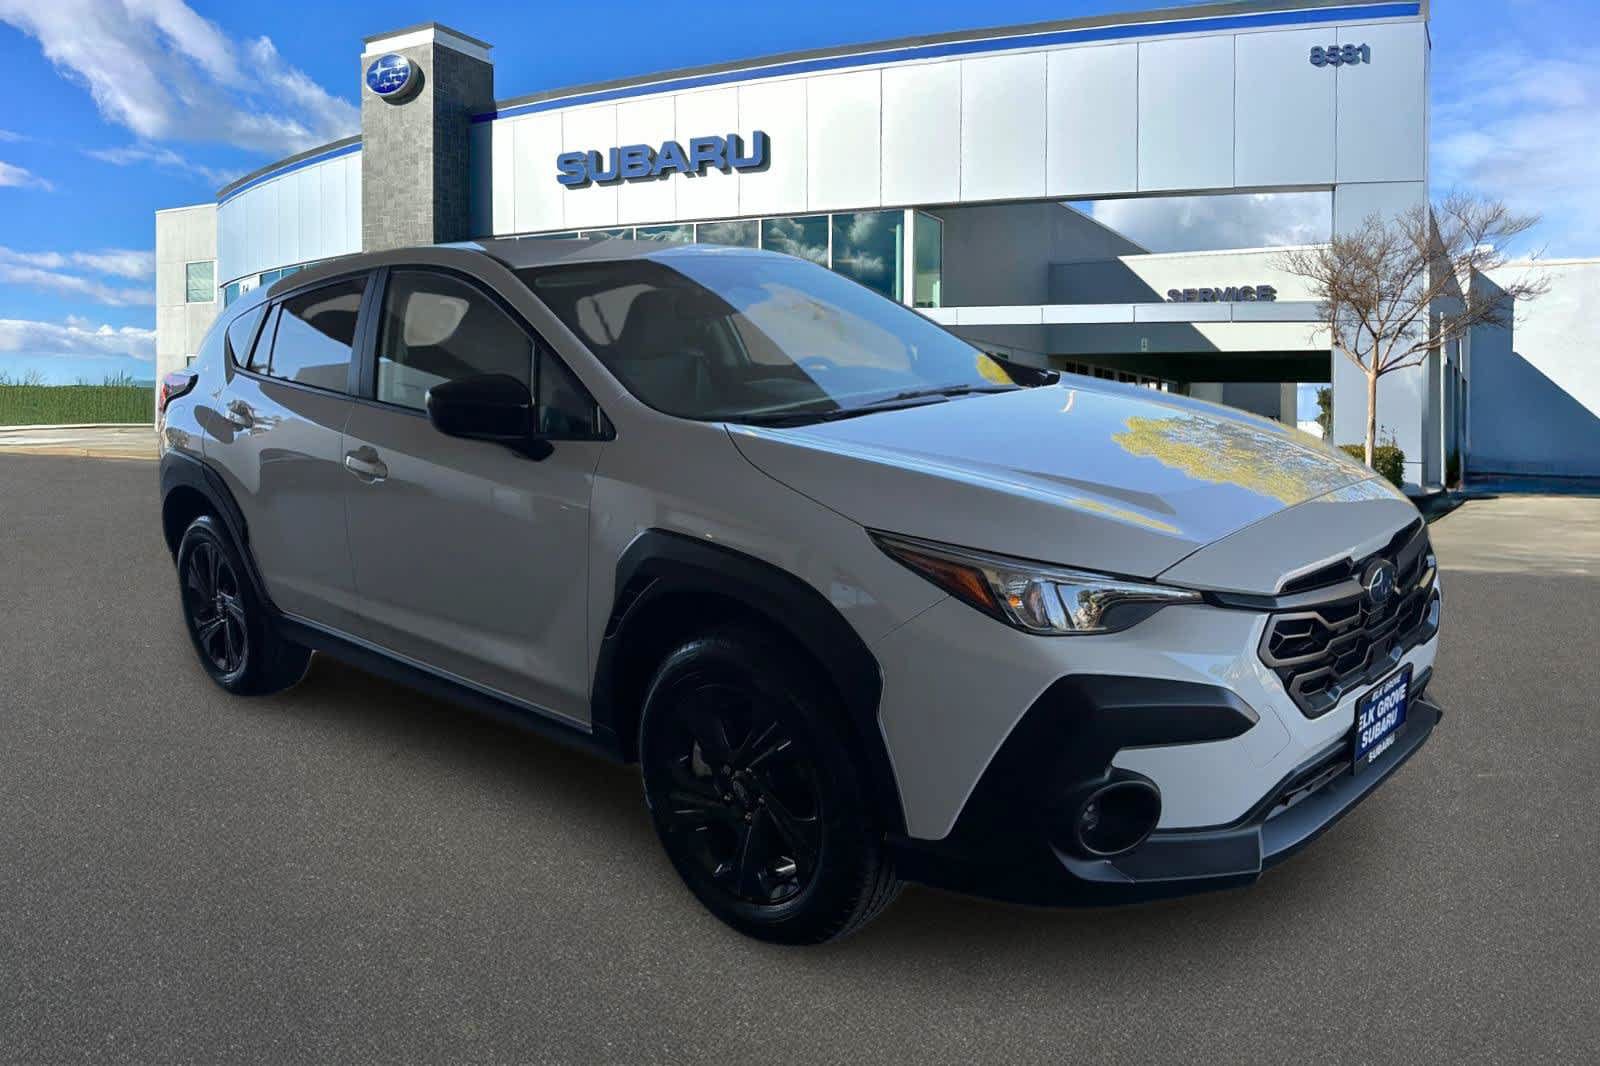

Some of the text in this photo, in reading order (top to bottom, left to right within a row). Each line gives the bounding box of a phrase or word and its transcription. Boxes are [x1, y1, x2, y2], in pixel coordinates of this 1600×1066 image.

[556, 130, 770, 190] SUBARU
[1166, 284, 1277, 303] SERVICE
[1358, 707, 1377, 733] ELK
[1376, 682, 1407, 718] GROVE
[1361, 707, 1399, 749] SUBARU
